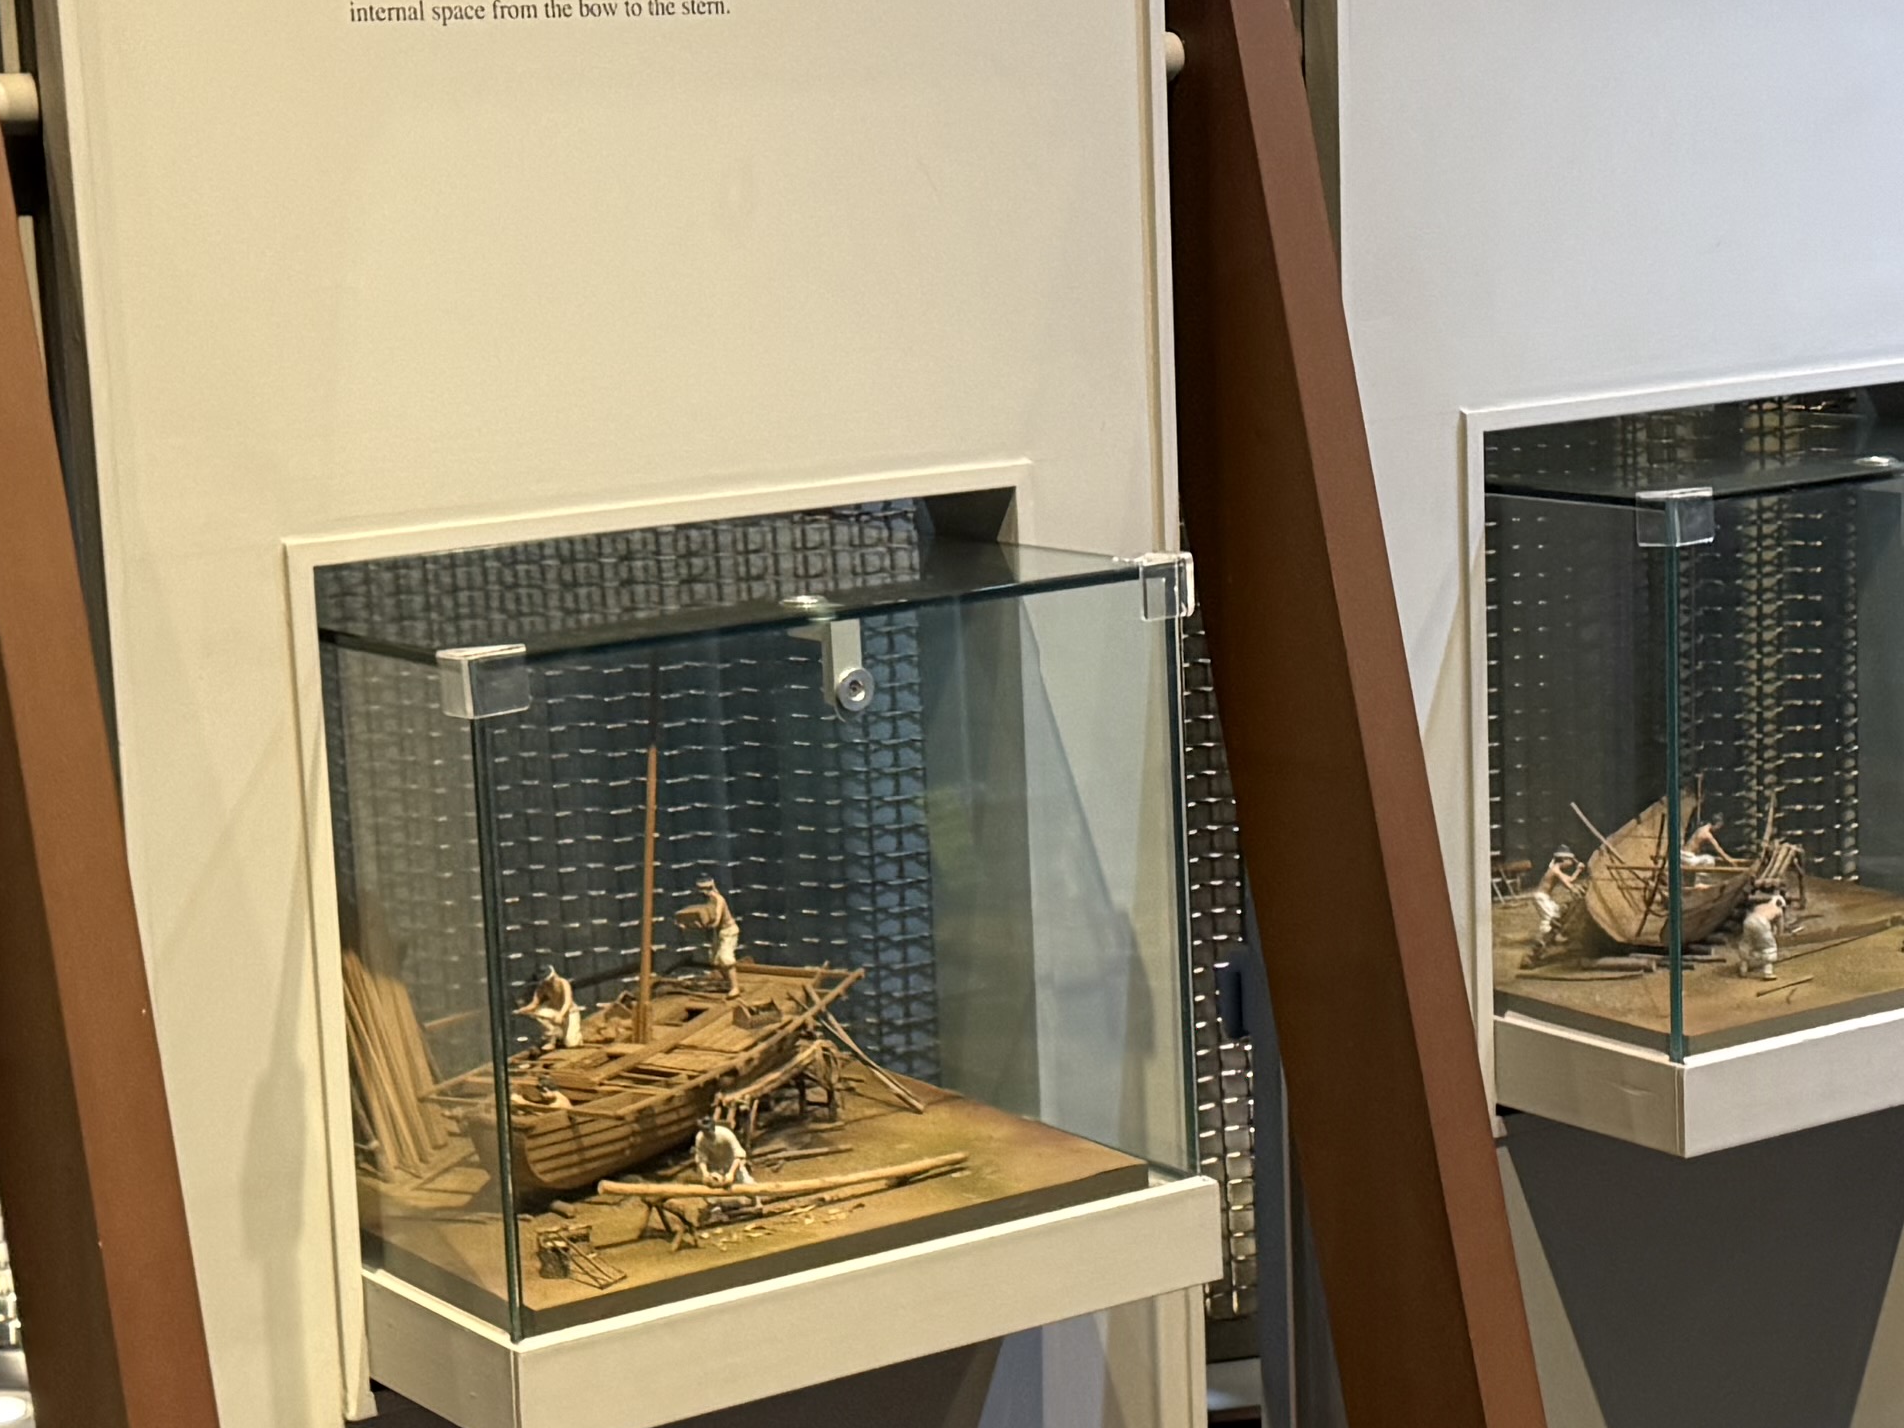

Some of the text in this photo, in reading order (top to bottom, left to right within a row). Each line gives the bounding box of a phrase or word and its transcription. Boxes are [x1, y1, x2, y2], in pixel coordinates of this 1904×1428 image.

[349, 0, 425, 23] internal
[431, 4, 486, 27] space
[623, 0, 643, 18] to
